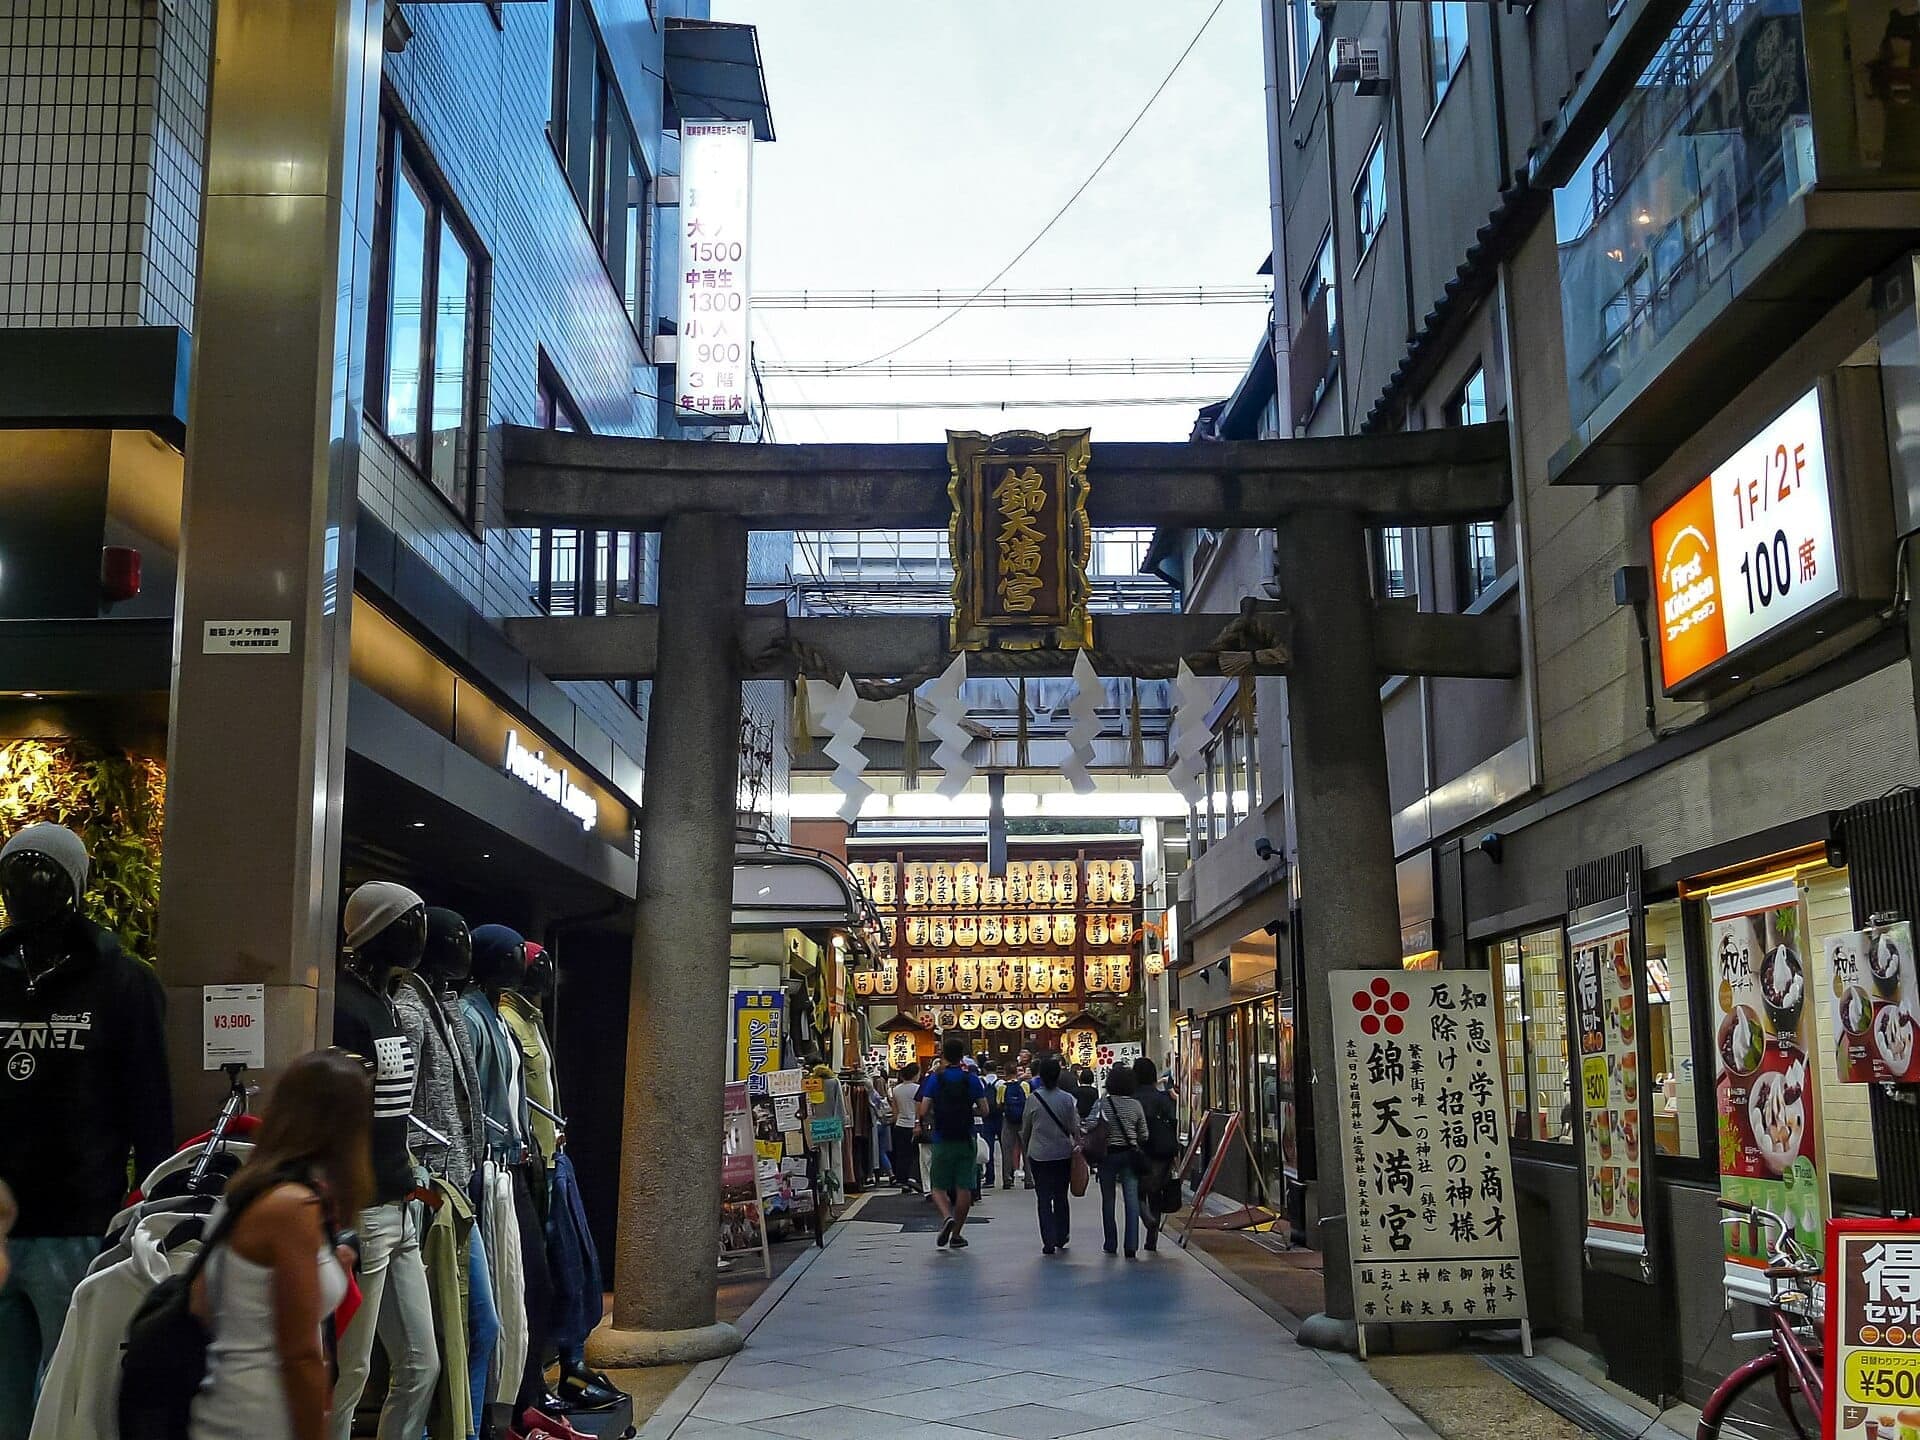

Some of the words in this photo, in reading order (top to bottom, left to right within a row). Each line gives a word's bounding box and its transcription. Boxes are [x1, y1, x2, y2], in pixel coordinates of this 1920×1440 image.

[690, 242, 742, 262] 1500
[686, 269, 732, 289] 中高生
[689, 292, 741, 312] 1300
[698, 343, 740, 363] 900
[681, 394, 742, 411] 年中無休
[992, 467, 1047, 612] 錦天満宮
[1671, 552, 1701, 592] First
[1664, 576, 1714, 624] Kitchen
[0, 1029, 85, 1050] ANEL
[749, 1019, 767, 1095] シニア割
[1586, 1073, 1606, 1100] ¥500
[1427, 983, 1478, 1243] 厄除け・招福の神様
[1366, 1040, 1416, 1252] 錦天満宮
[1380, 1269, 1394, 1316] おみくじ
[1416, 1268, 1434, 1315] 神矢
[1460, 1267, 1476, 1314] 御守
[1862, 1242, 1920, 1302] 得
